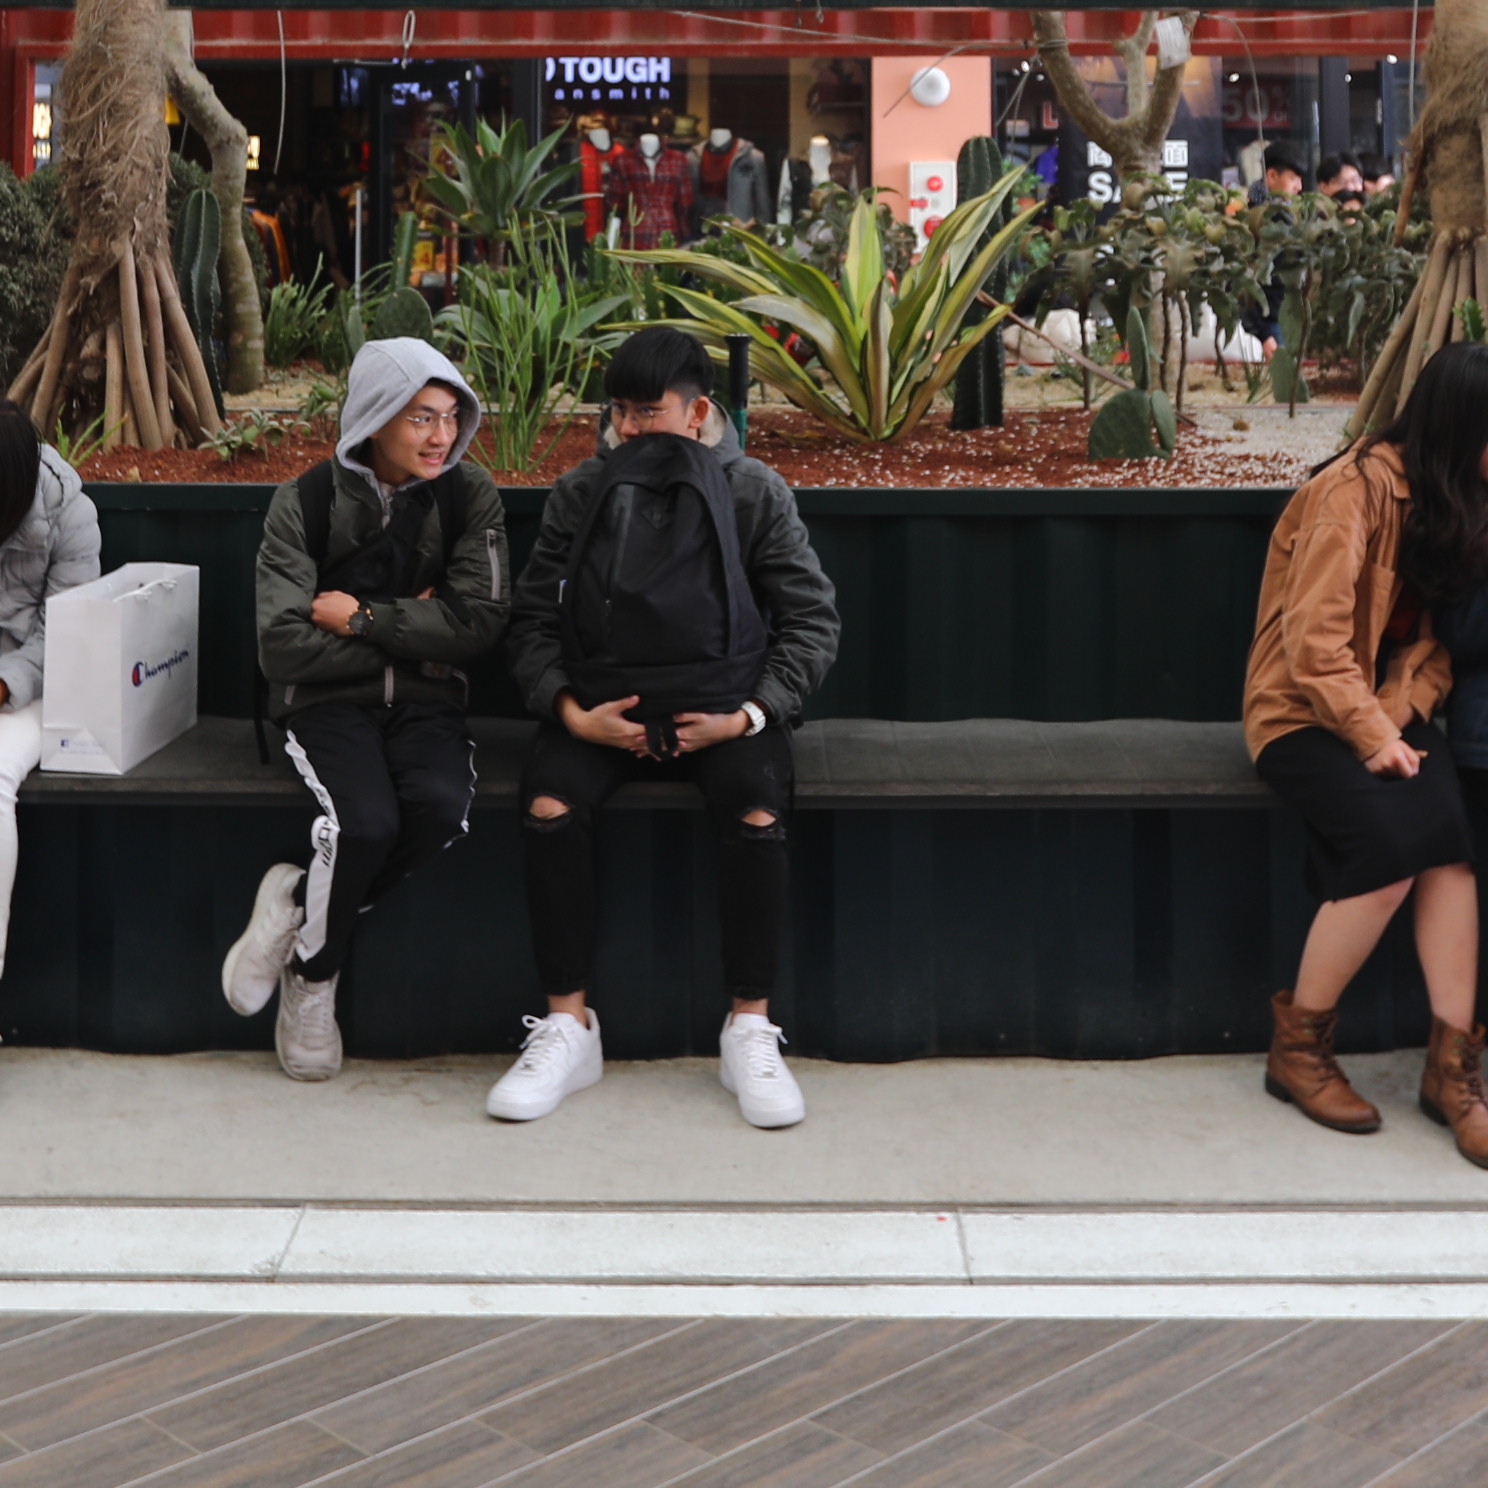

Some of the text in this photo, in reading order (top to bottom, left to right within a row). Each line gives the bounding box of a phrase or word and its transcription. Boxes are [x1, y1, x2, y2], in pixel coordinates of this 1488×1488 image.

[558, 56, 671, 84] TOUGH
[1087, 170, 1189, 204] SE
[131, 648, 190, 688] Champion
